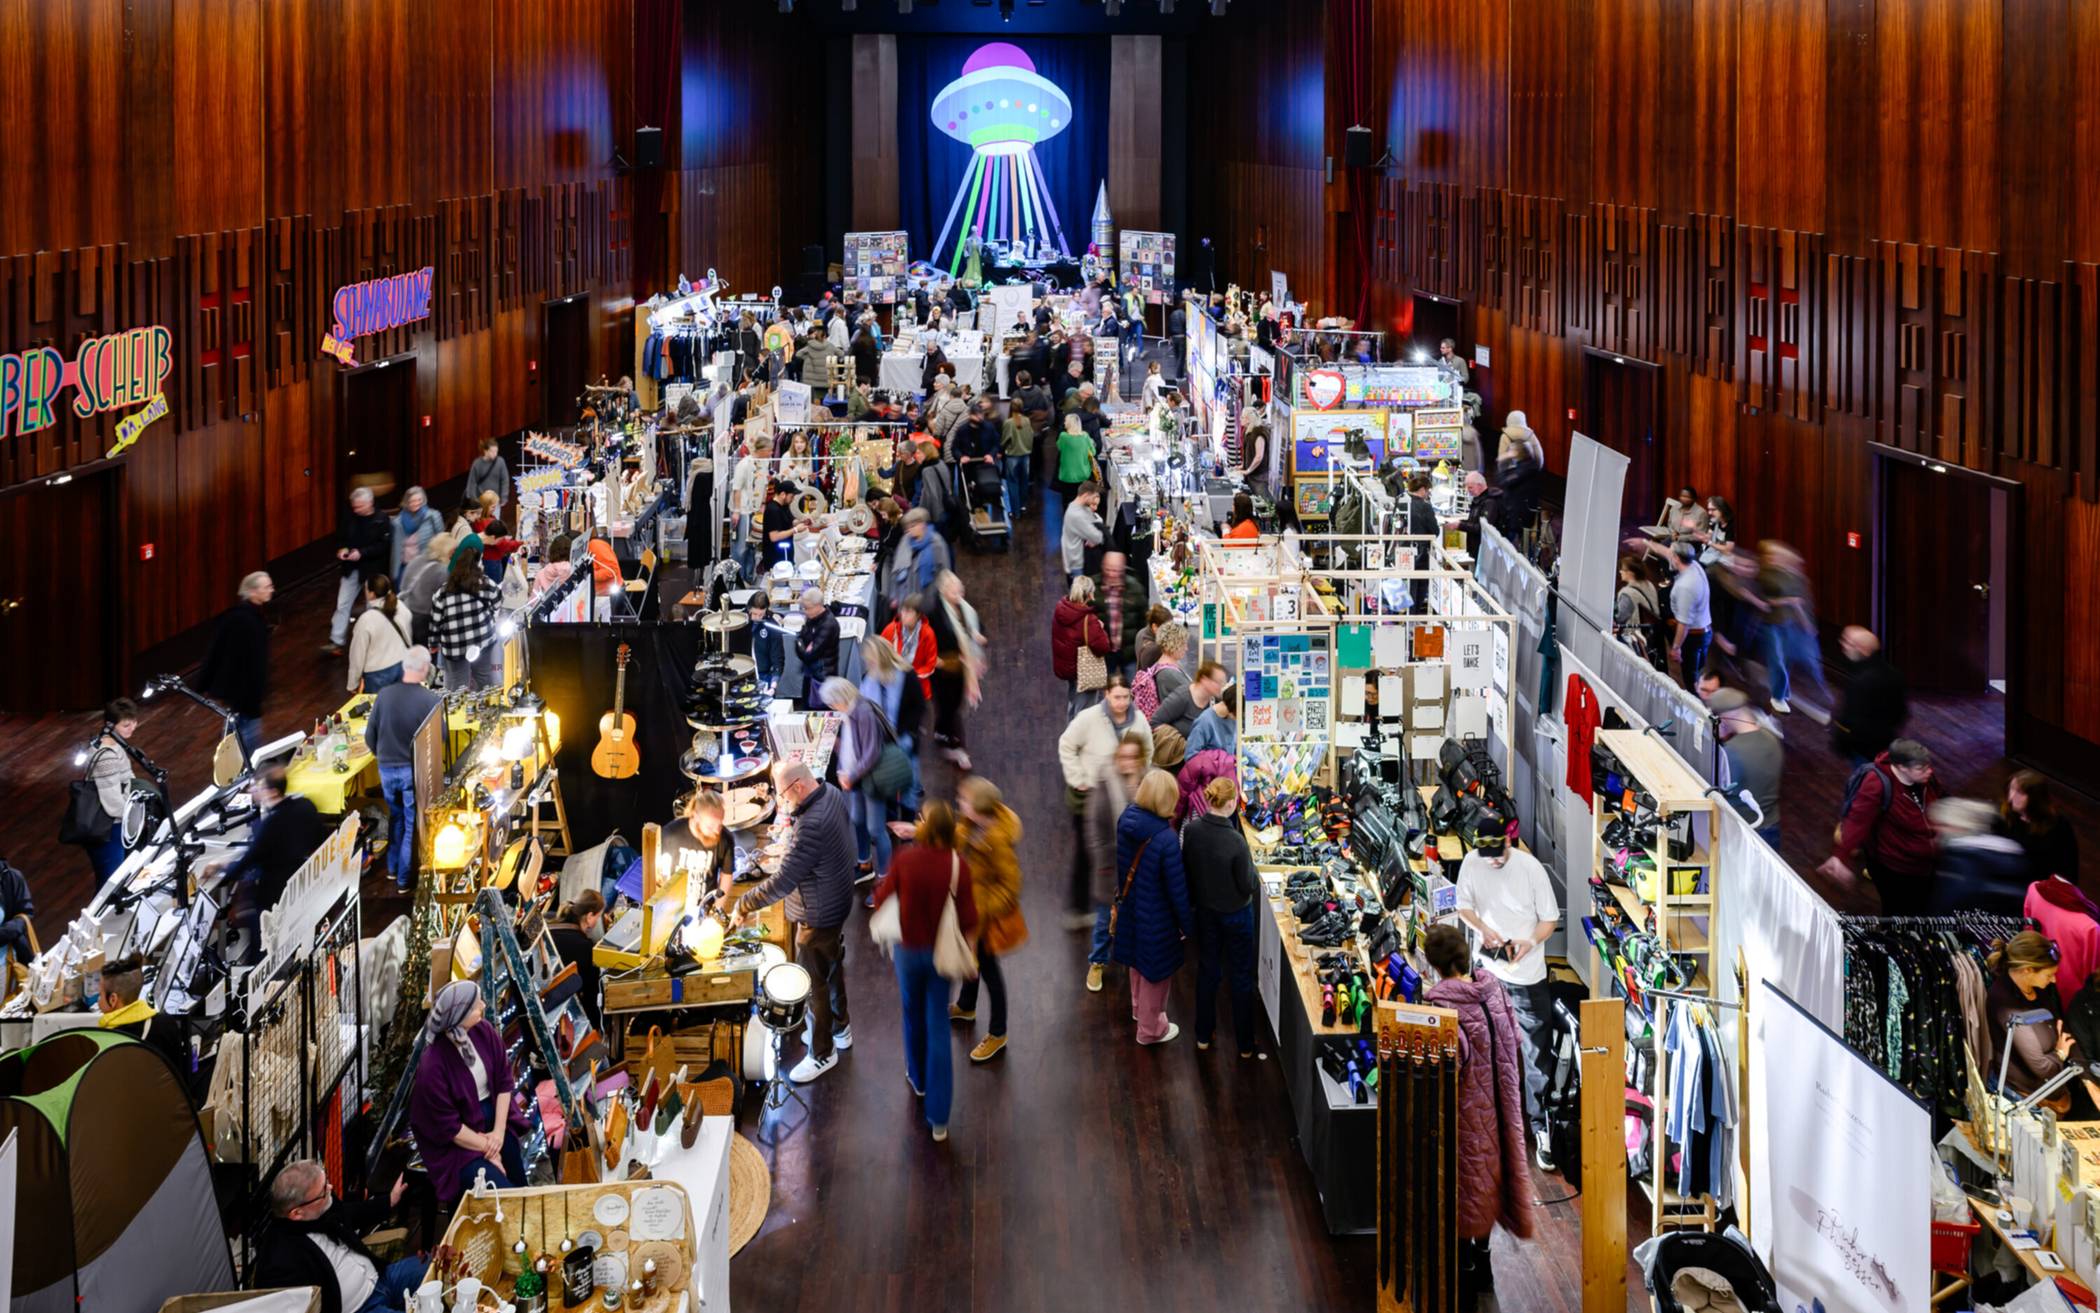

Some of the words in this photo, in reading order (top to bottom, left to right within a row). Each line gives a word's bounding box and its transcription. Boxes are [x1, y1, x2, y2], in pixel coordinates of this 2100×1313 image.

[334, 267, 434, 343] SCHNABULANZ
[1463, 644, 1480, 656] LET'S
[289, 836, 336, 906] UNIQUE
